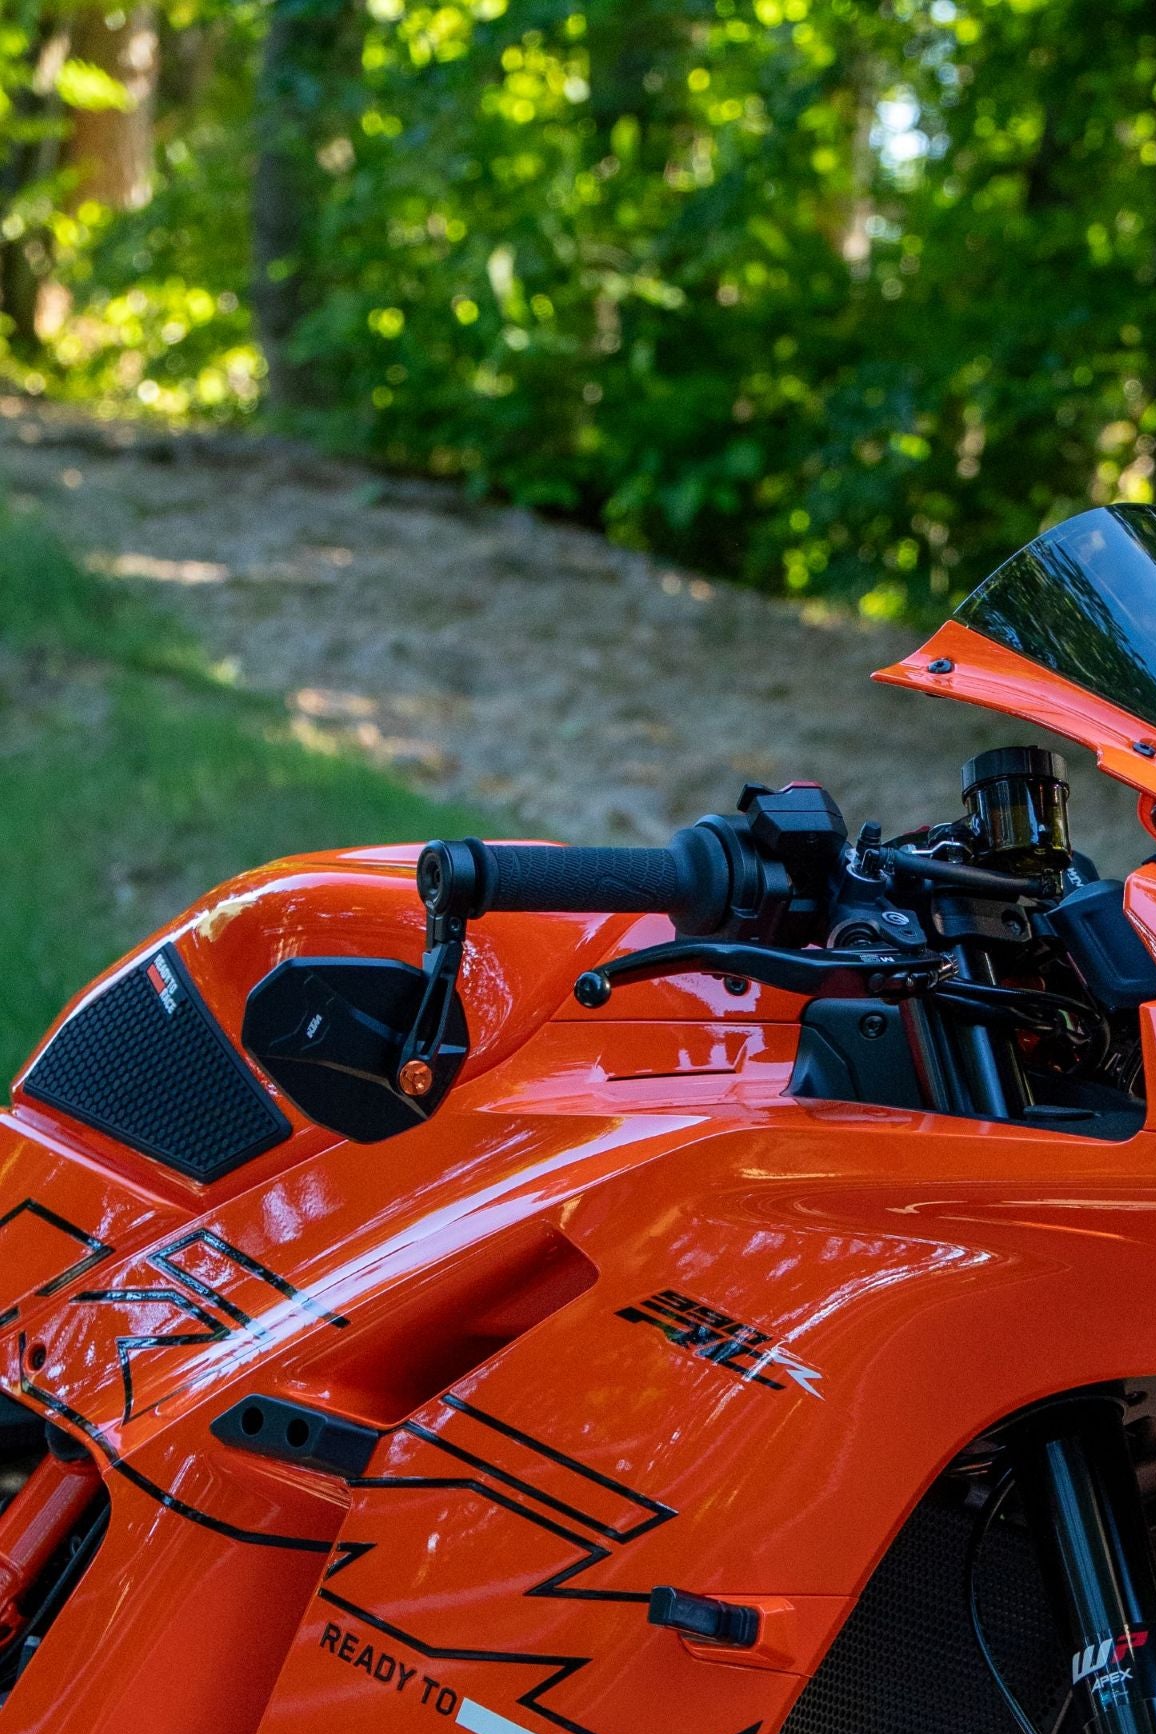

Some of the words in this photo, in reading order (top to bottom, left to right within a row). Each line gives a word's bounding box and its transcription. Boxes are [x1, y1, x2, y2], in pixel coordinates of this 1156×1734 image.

[166, 977, 178, 995] TO
[159, 987, 178, 1014] RACE
[306, 1013, 323, 1039] KTM
[640, 1288, 772, 1345] 990
[319, 1621, 418, 1692] READY
[420, 1675, 458, 1716] TO
[1071, 1630, 1149, 1686] WP
[1091, 1667, 1134, 1694] APEX
